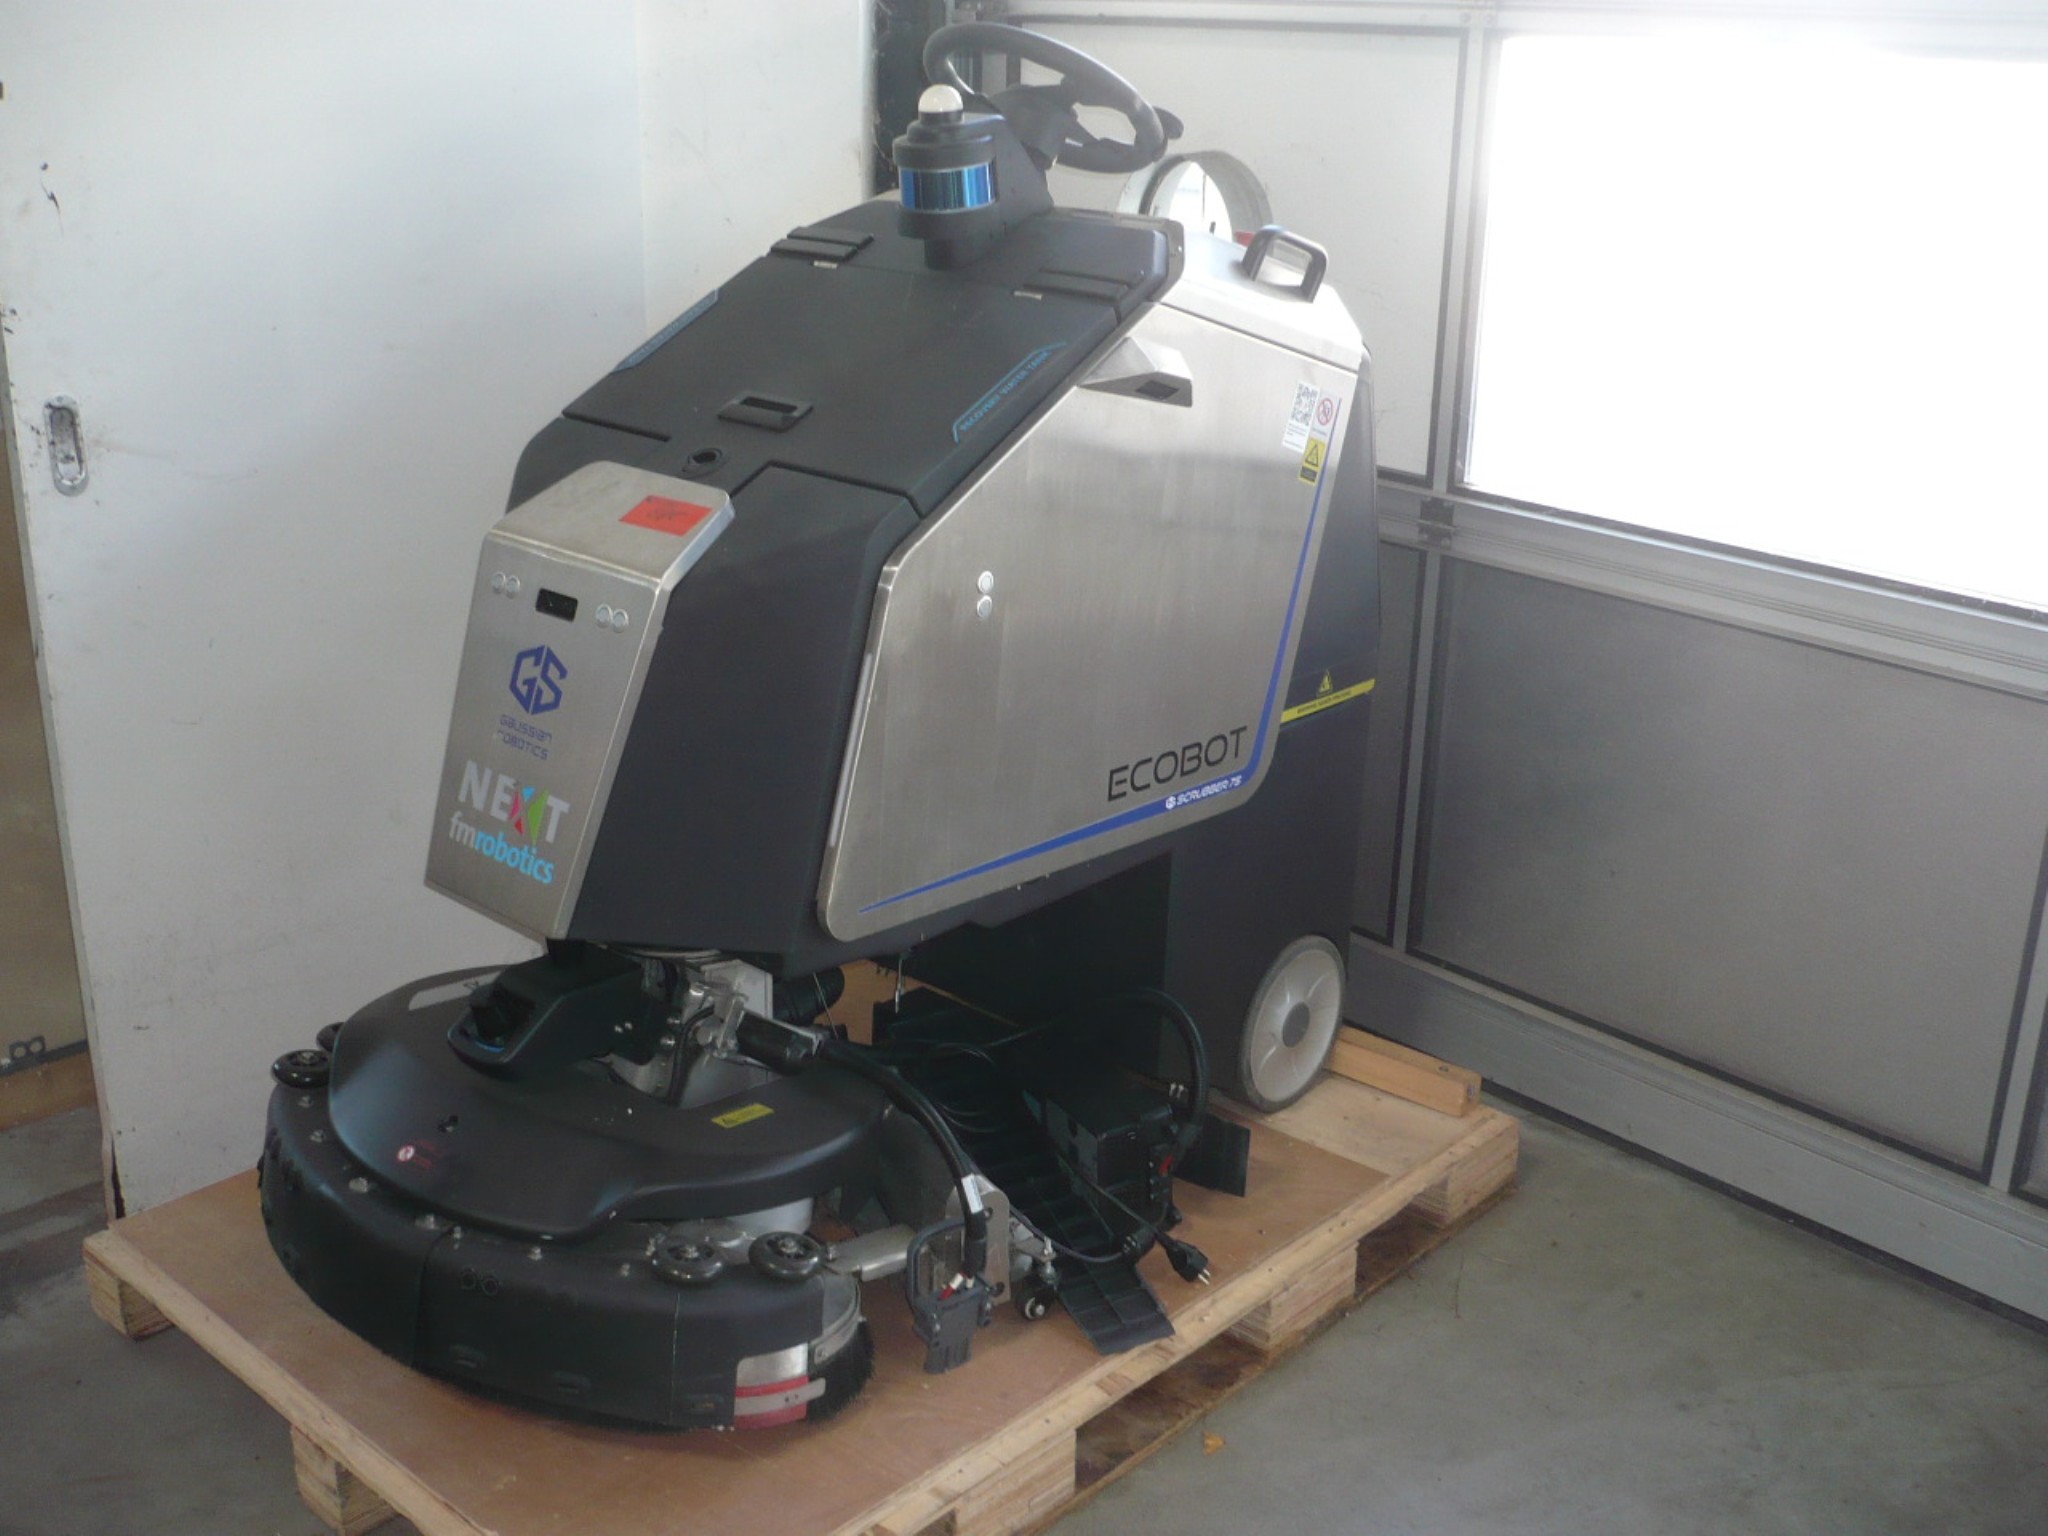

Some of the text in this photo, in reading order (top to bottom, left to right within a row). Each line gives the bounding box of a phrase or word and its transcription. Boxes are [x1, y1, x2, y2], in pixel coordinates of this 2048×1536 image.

[1107, 725, 1248, 802] ECOBOT
[458, 759, 571, 849] NEXT
[449, 810, 555, 885] fmrobotics
